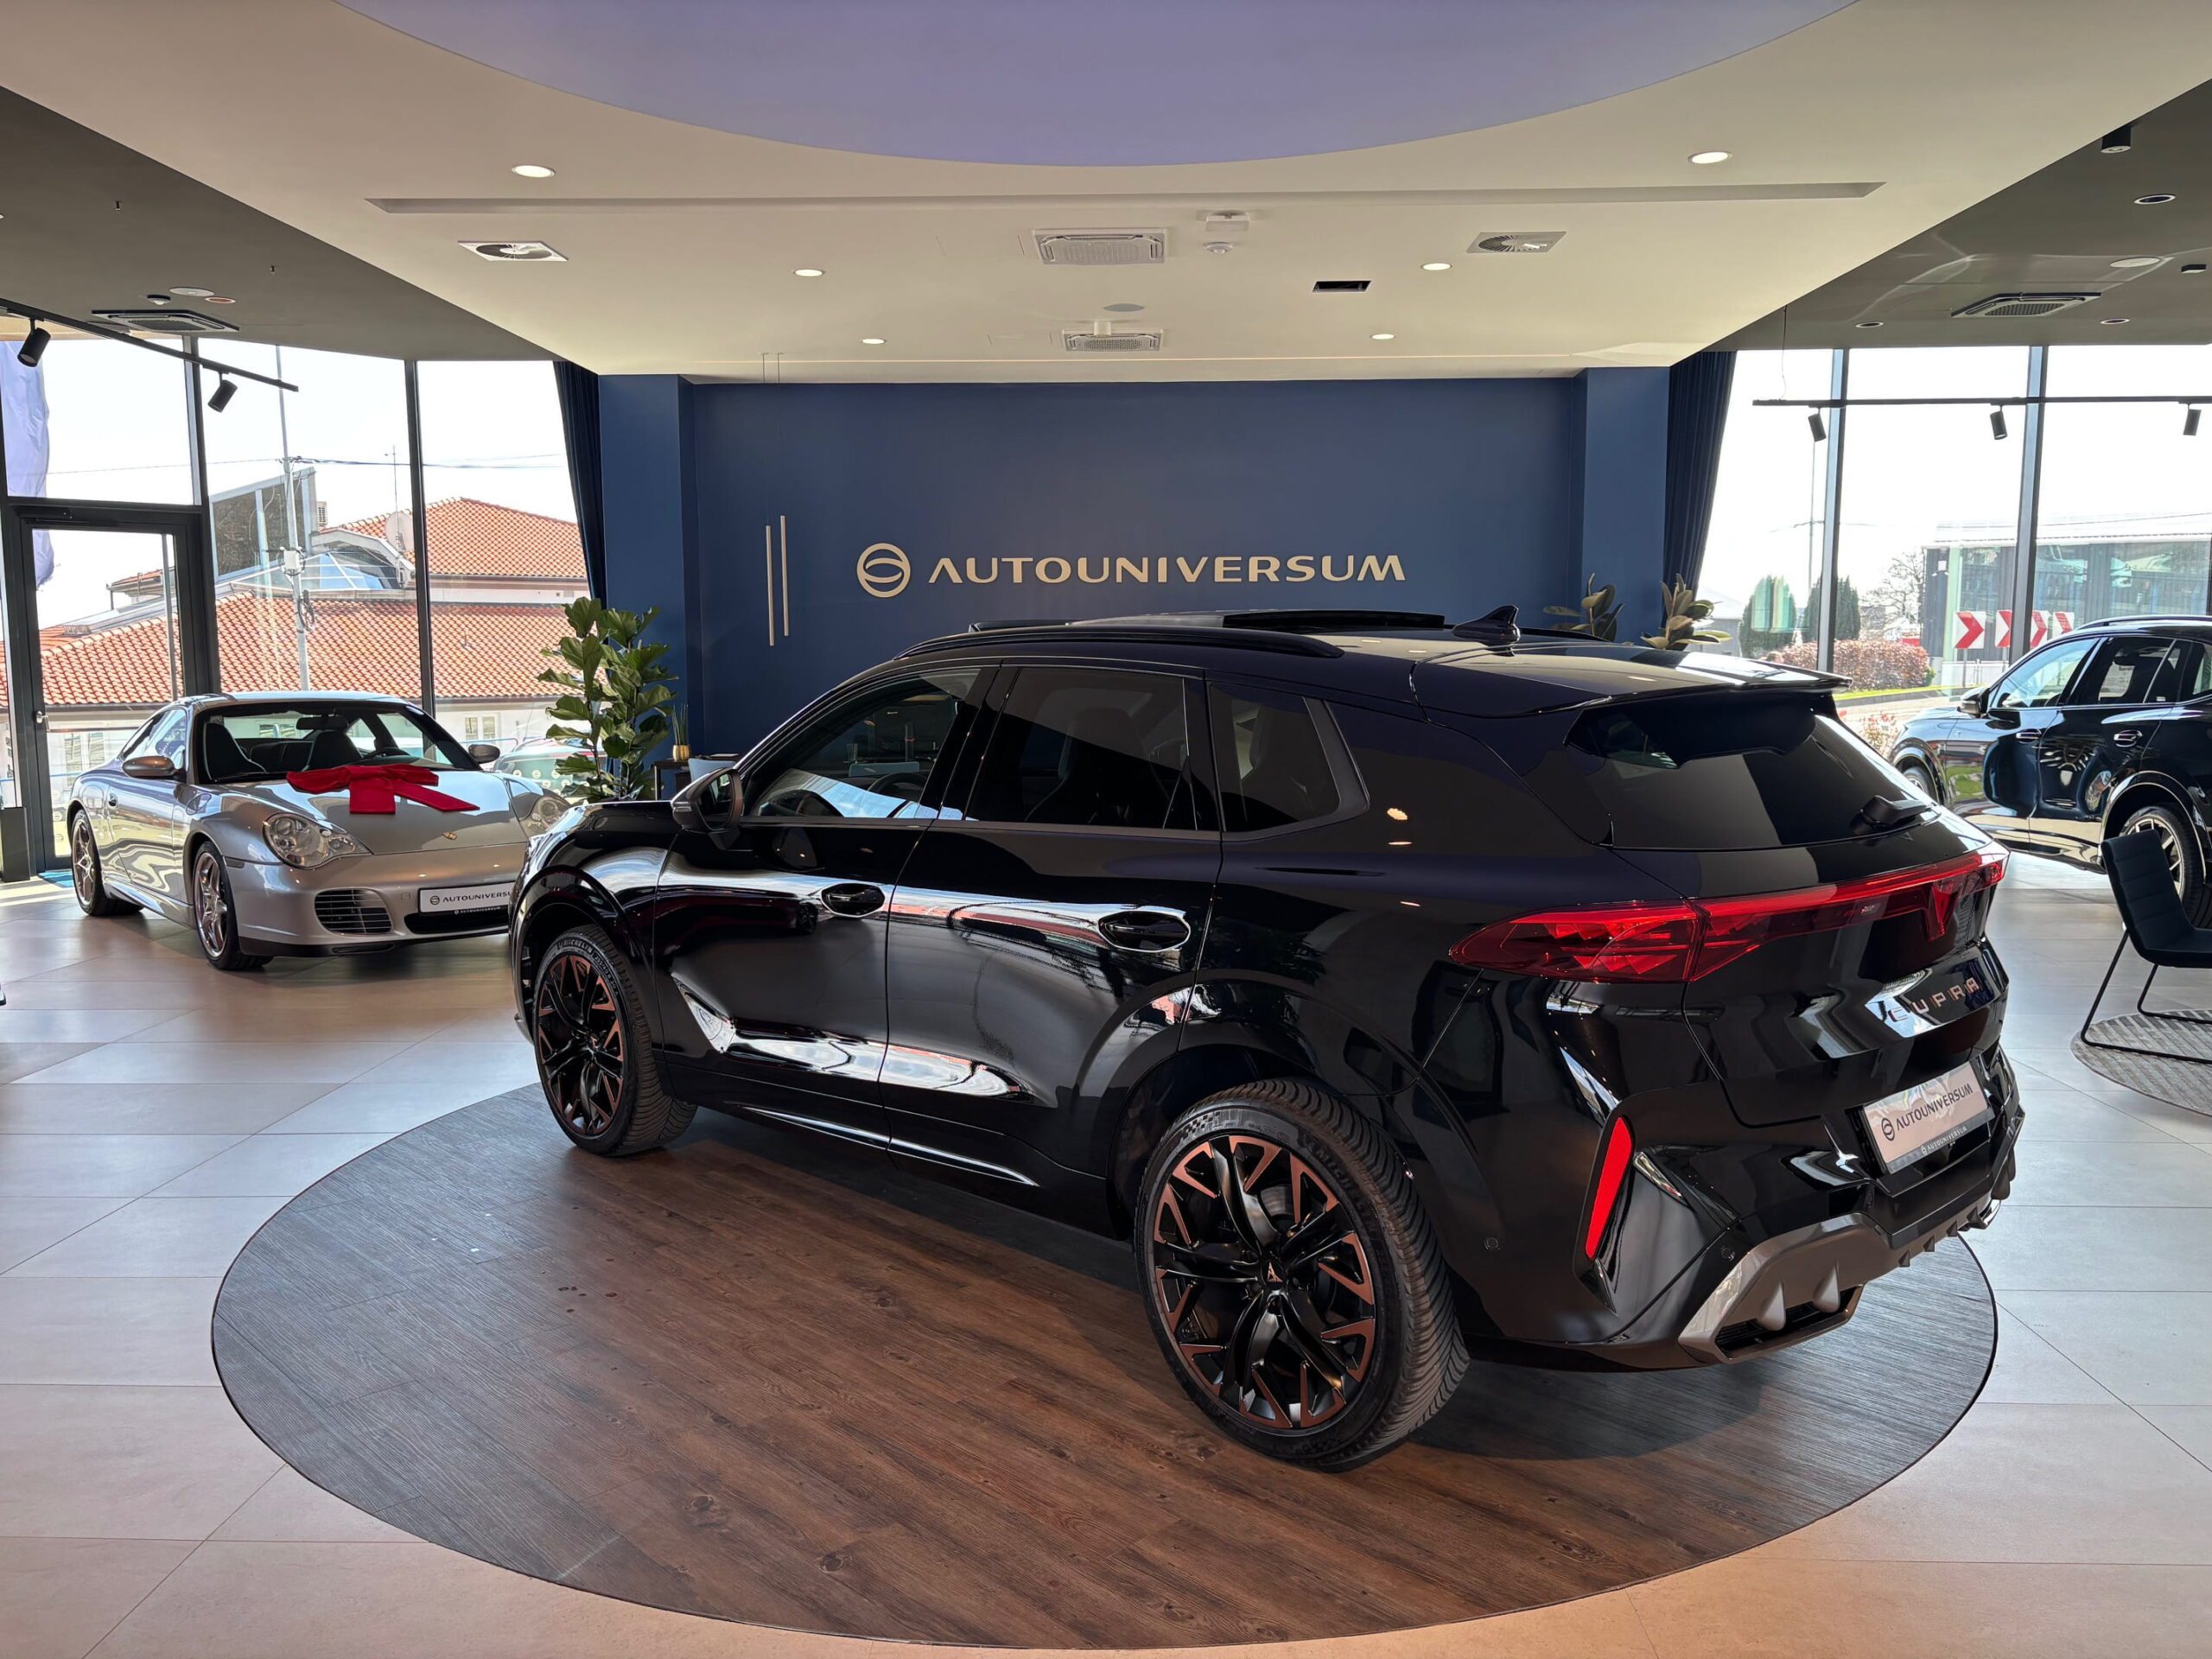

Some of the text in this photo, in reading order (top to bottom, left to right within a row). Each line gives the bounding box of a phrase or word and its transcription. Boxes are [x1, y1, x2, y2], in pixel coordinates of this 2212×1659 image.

[928, 555, 1406, 583] AUTOUNIVERSUM
[442, 891, 512, 903] AUTOUNIVERSU
[1888, 977, 1980, 1022] CUPRA
[1896, 1083, 1974, 1132] AUTOUNIVERSUM
[1927, 1126, 1967, 1152] AUTOUNIVERSUM
